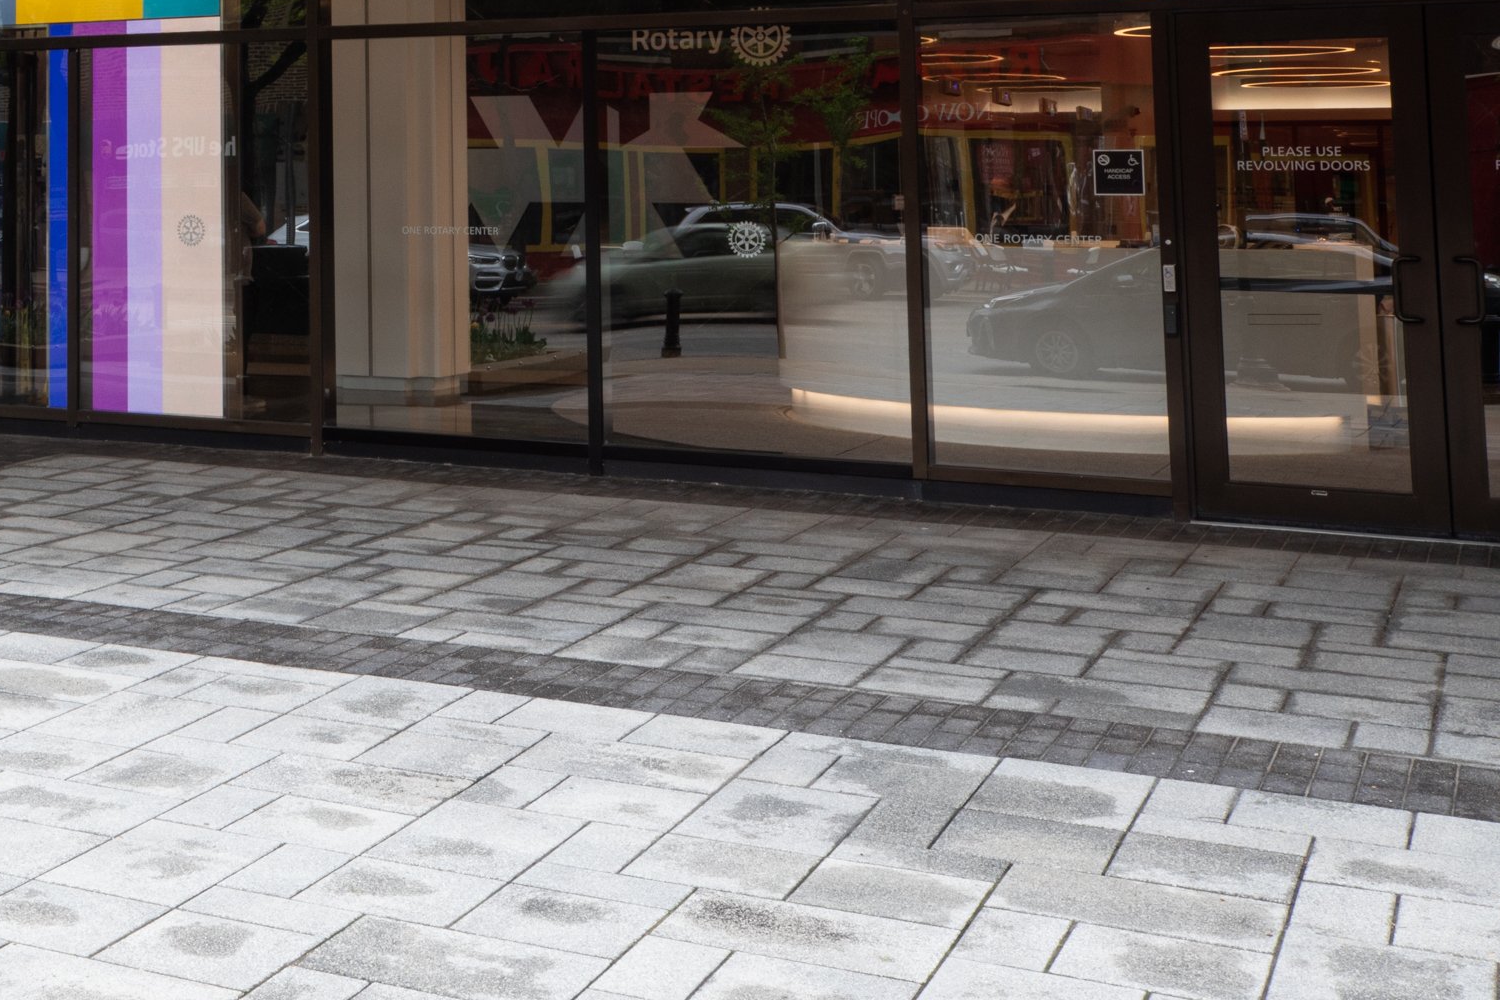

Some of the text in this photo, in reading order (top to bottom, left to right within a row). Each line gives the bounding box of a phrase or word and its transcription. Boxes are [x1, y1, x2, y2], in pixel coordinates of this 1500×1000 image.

[632, 28, 723, 54] Rotary
[1262, 146, 1342, 157] PLEASE USE
[1237, 160, 1371, 172] REVOLVING DOORS
[402, 226, 499, 236] ONE ROTARY CENTER
[975, 233, 1103, 244] ONE ROTARY CENTER
